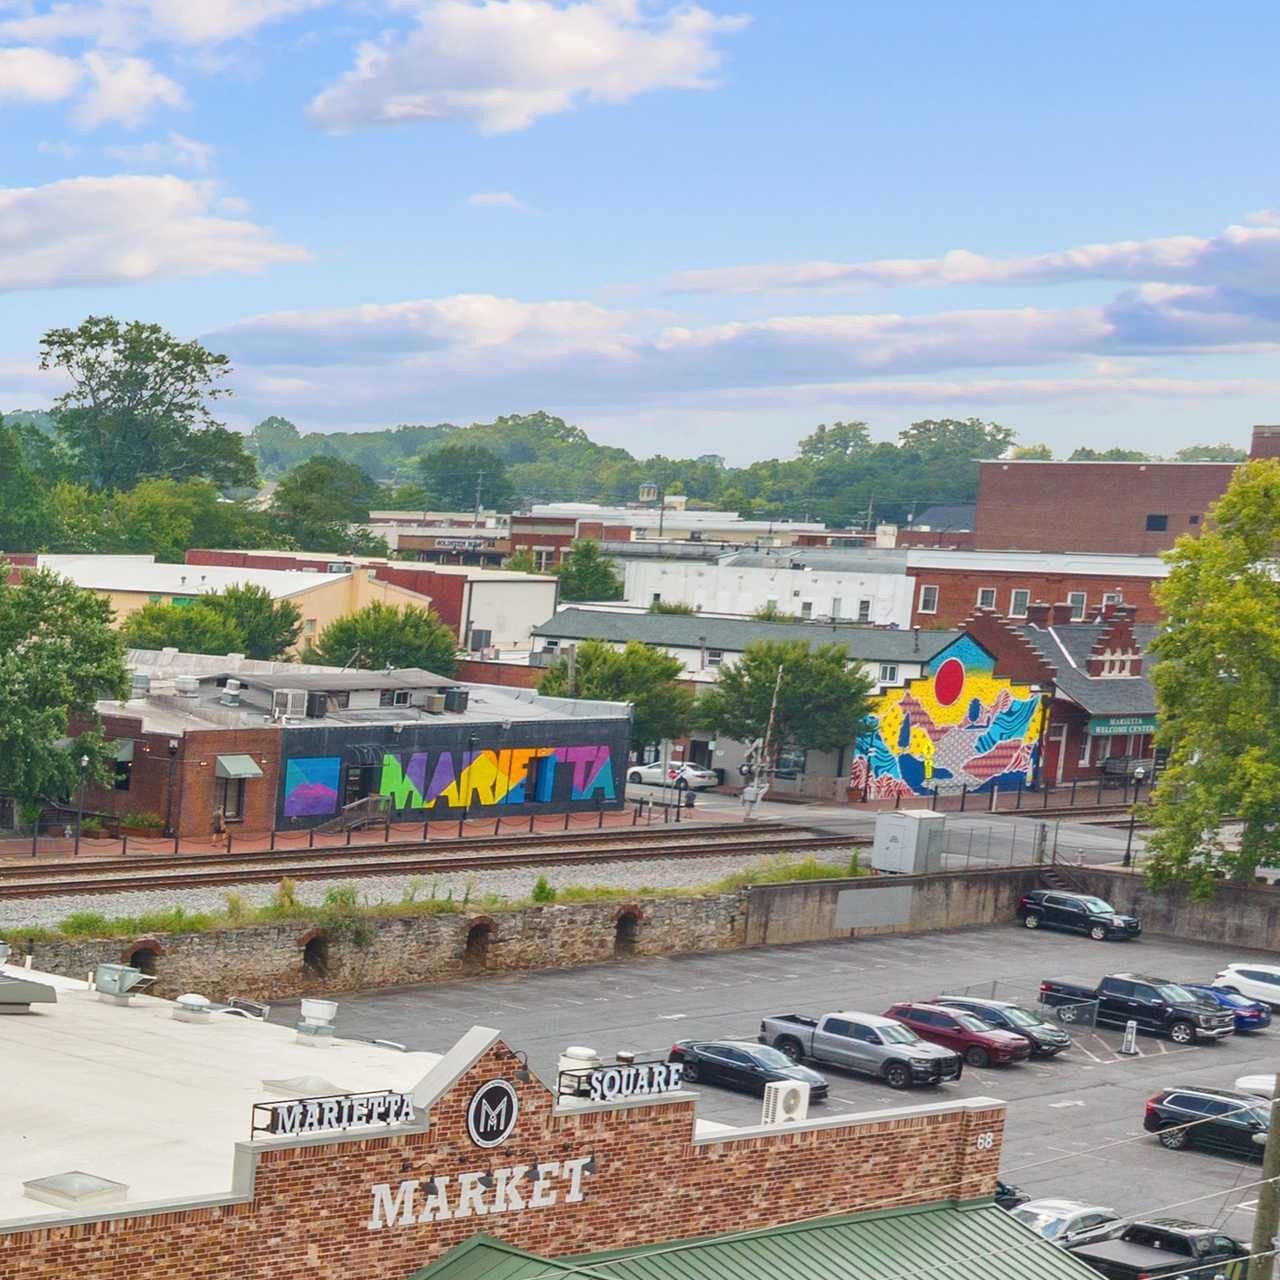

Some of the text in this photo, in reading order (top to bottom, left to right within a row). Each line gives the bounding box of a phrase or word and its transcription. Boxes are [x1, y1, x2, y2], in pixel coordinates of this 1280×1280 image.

[379, 746, 616, 810] MARIETTA
[590, 1063, 684, 1099] SQUARE
[277, 1094, 416, 1134] MARIETTA
[977, 1132, 993, 1150] 68
[367, 1157, 594, 1230] MARKET
